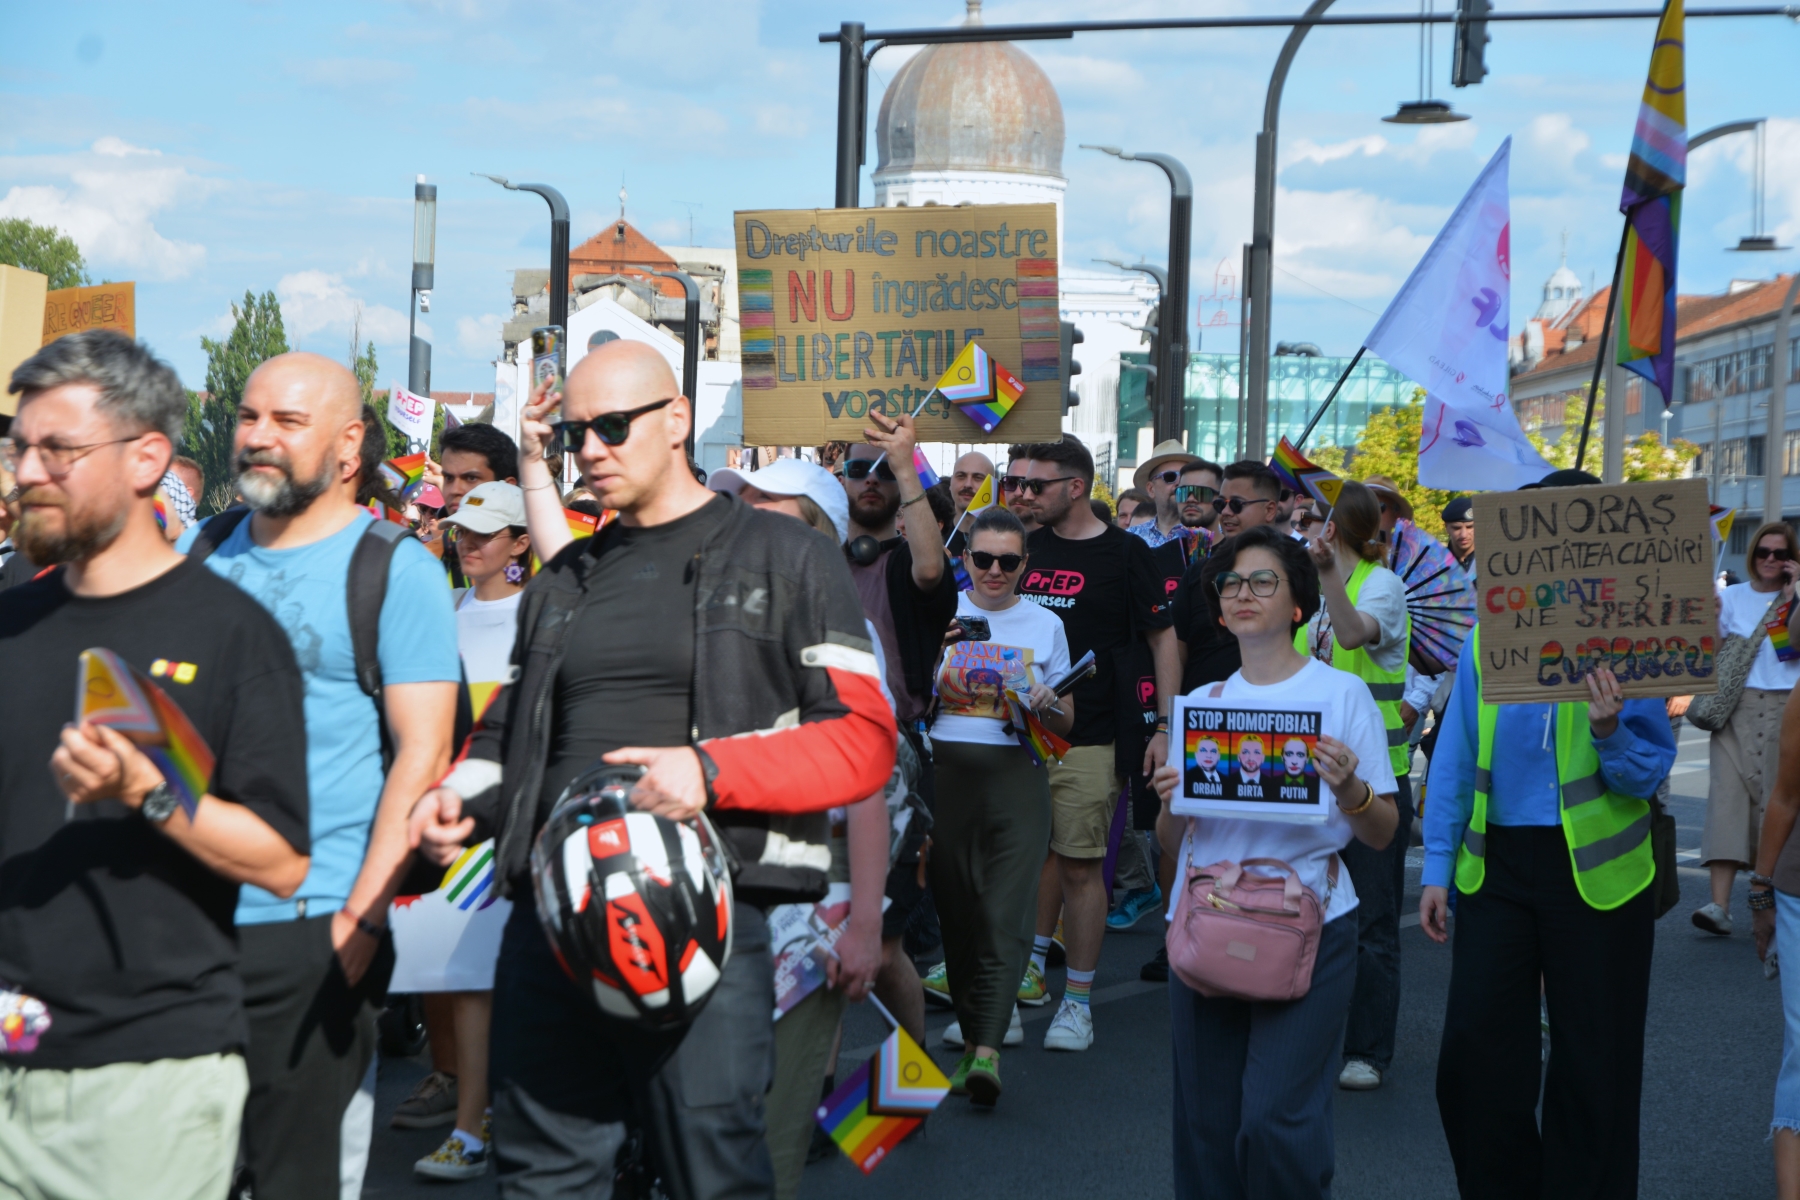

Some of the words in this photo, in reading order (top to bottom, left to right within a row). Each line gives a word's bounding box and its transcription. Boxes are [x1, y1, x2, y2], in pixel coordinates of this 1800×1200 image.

[745, 218, 898, 260] Drepturile
[915, 222, 1049, 259] noastre
[43, 302, 67, 335] RE
[69, 291, 128, 328] QUEER
[788, 269, 855, 323] NU
[871, 271, 1018, 318] îngrădesc
[1500, 502, 1559, 541] UN
[1565, 494, 1677, 535] ORAȘ
[1487, 551, 1523, 577] CU
[1526, 538, 1614, 575] ATÂTEA
[1024, 571, 1083, 592] PrEP
[1485, 577, 1618, 614] COLORATE
[1515, 606, 1558, 629] NE
[1490, 646, 1530, 671] UN
[1188, 709, 1224, 730] STOP
[1226, 712, 1317, 734] HOMOFOBIA!
[1192, 781, 1223, 796] ORBAN
[1237, 784, 1264, 798] BIRTA
[1280, 786, 1309, 800] PUTIN
